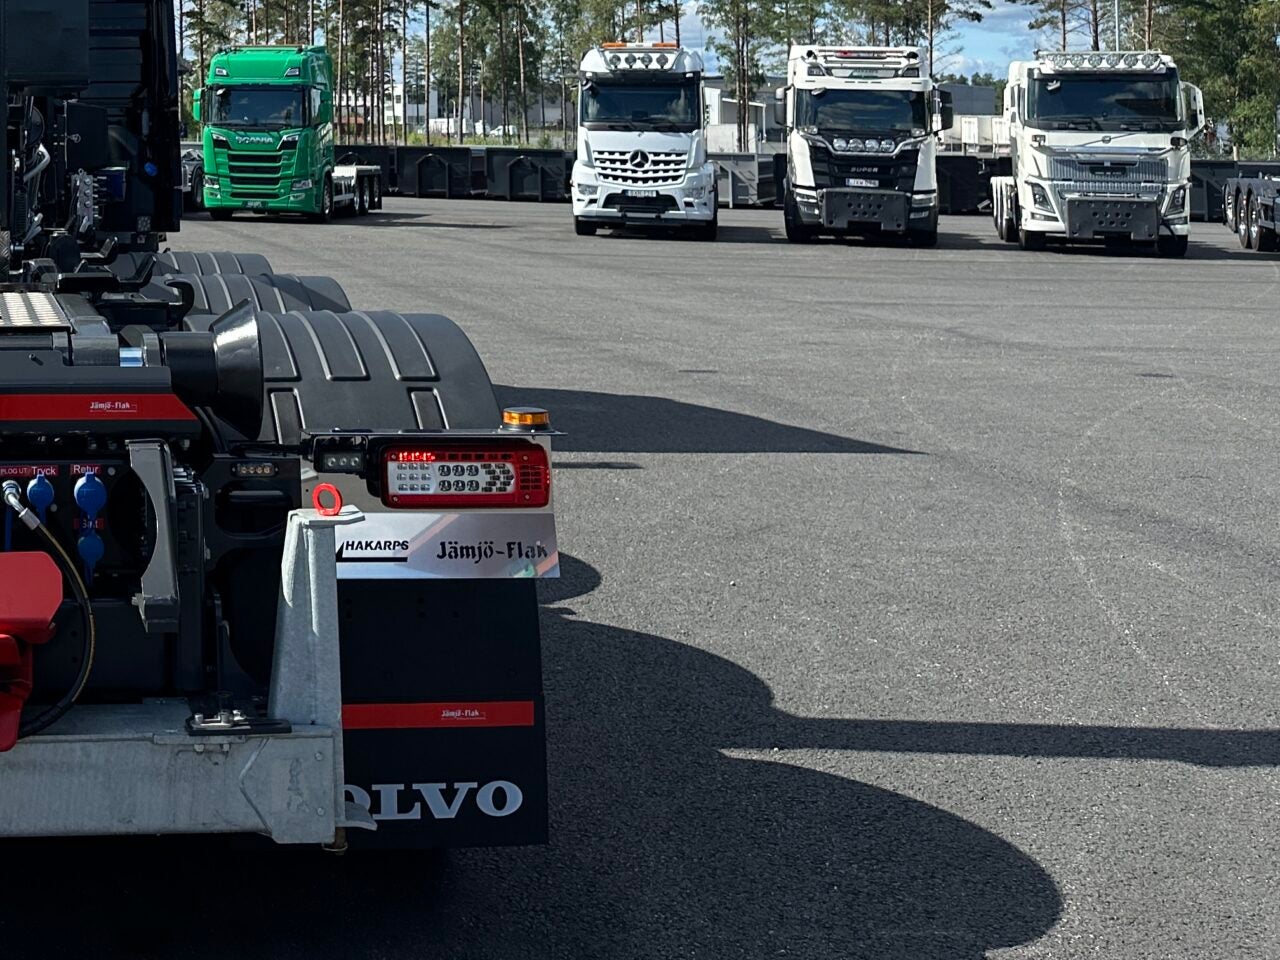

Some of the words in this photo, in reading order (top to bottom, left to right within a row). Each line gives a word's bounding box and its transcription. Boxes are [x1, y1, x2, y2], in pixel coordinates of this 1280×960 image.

[73, 465, 99, 474] Retur
[345, 540, 410, 551] HAKARPS
[436, 541, 548, 564] Jämjö-Flak
